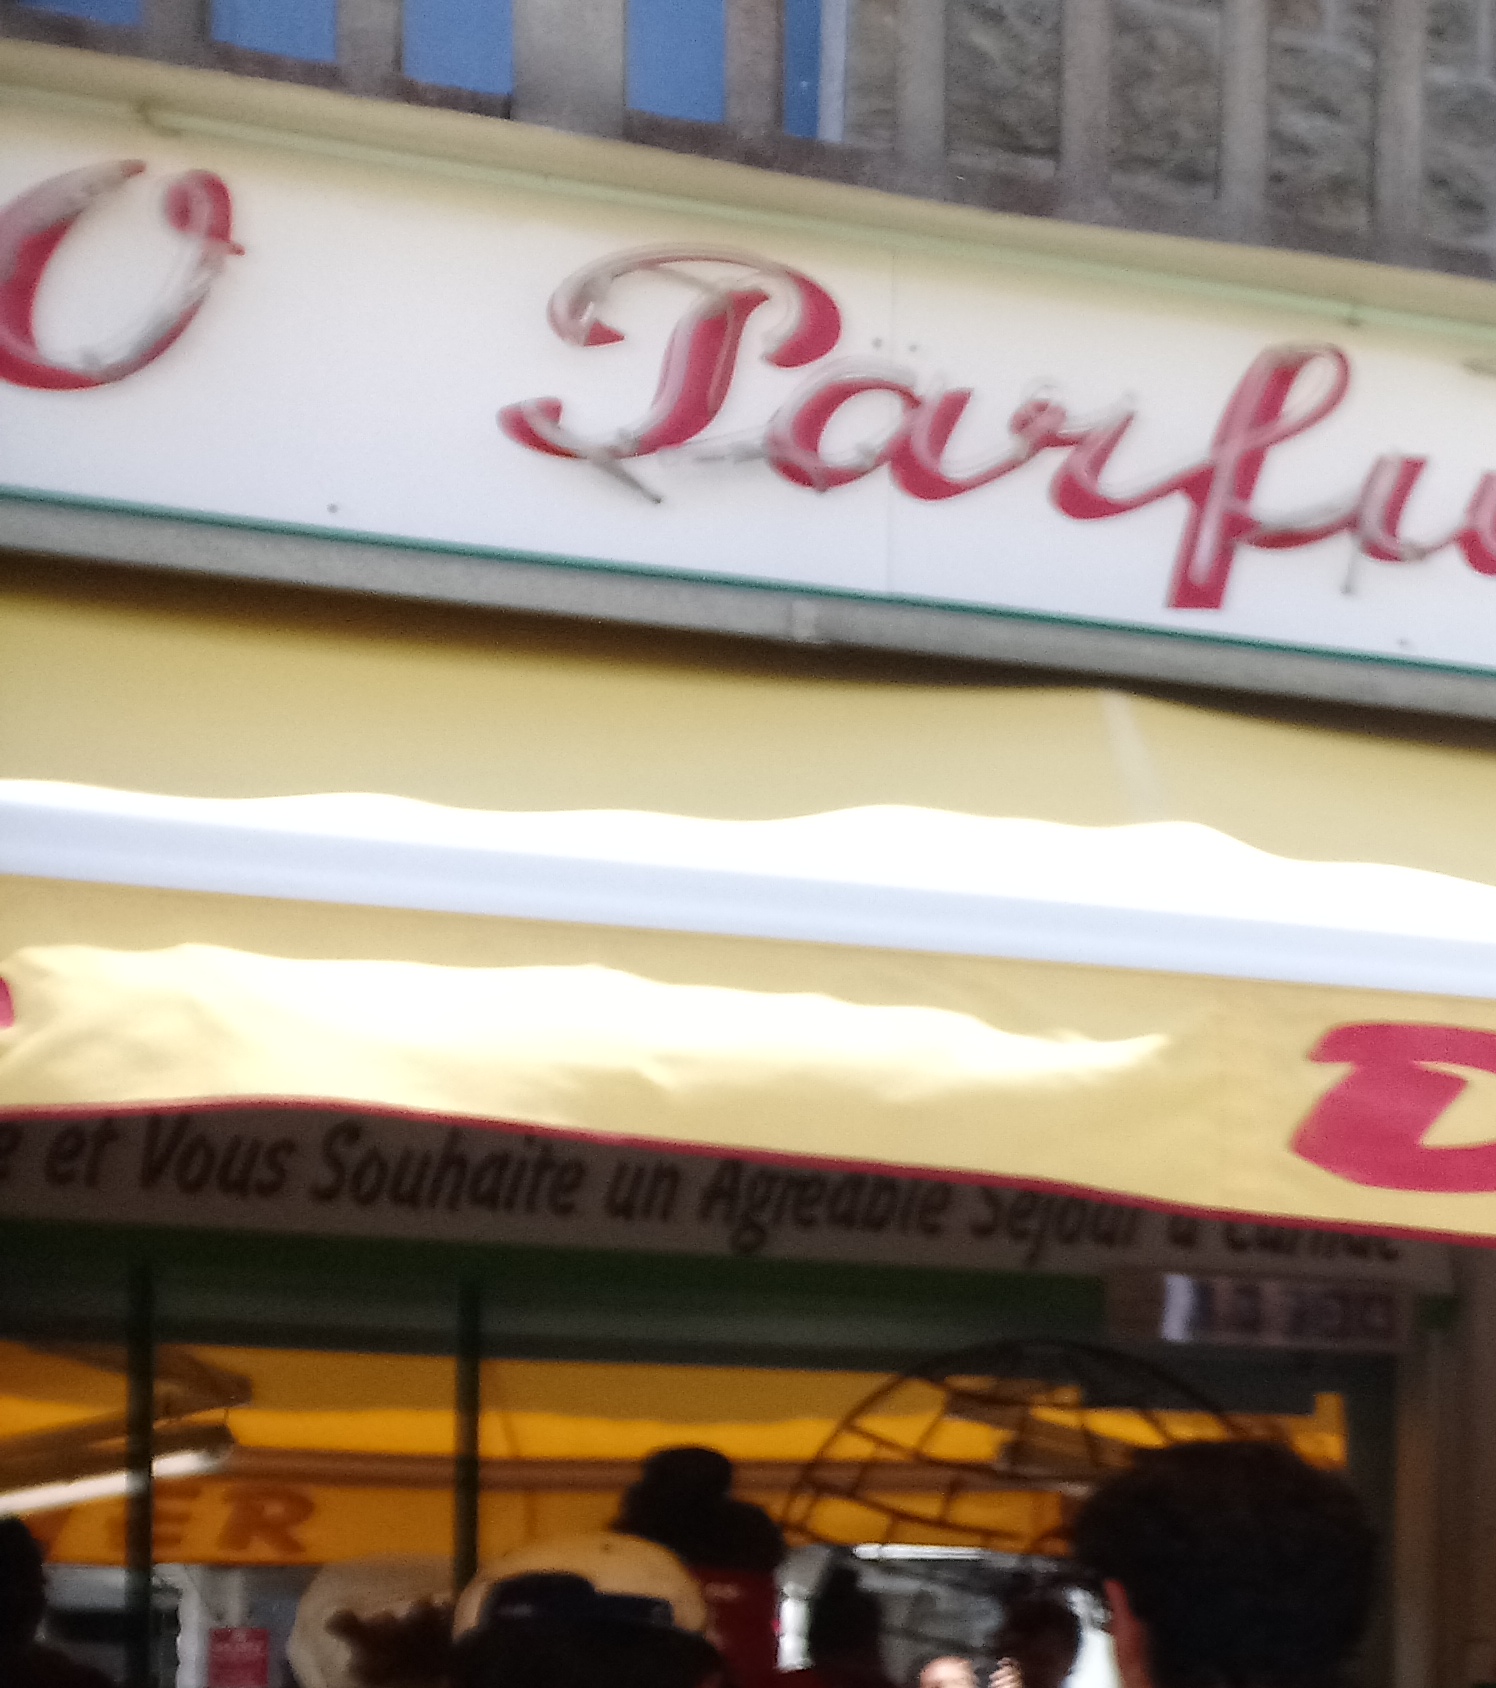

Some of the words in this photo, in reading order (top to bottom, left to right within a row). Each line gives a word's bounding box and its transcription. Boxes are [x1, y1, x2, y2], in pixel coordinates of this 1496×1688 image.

[135, 1108, 297, 1199] Vous
[308, 1119, 587, 1216] Souhaite
[606, 1154, 683, 1224] un
